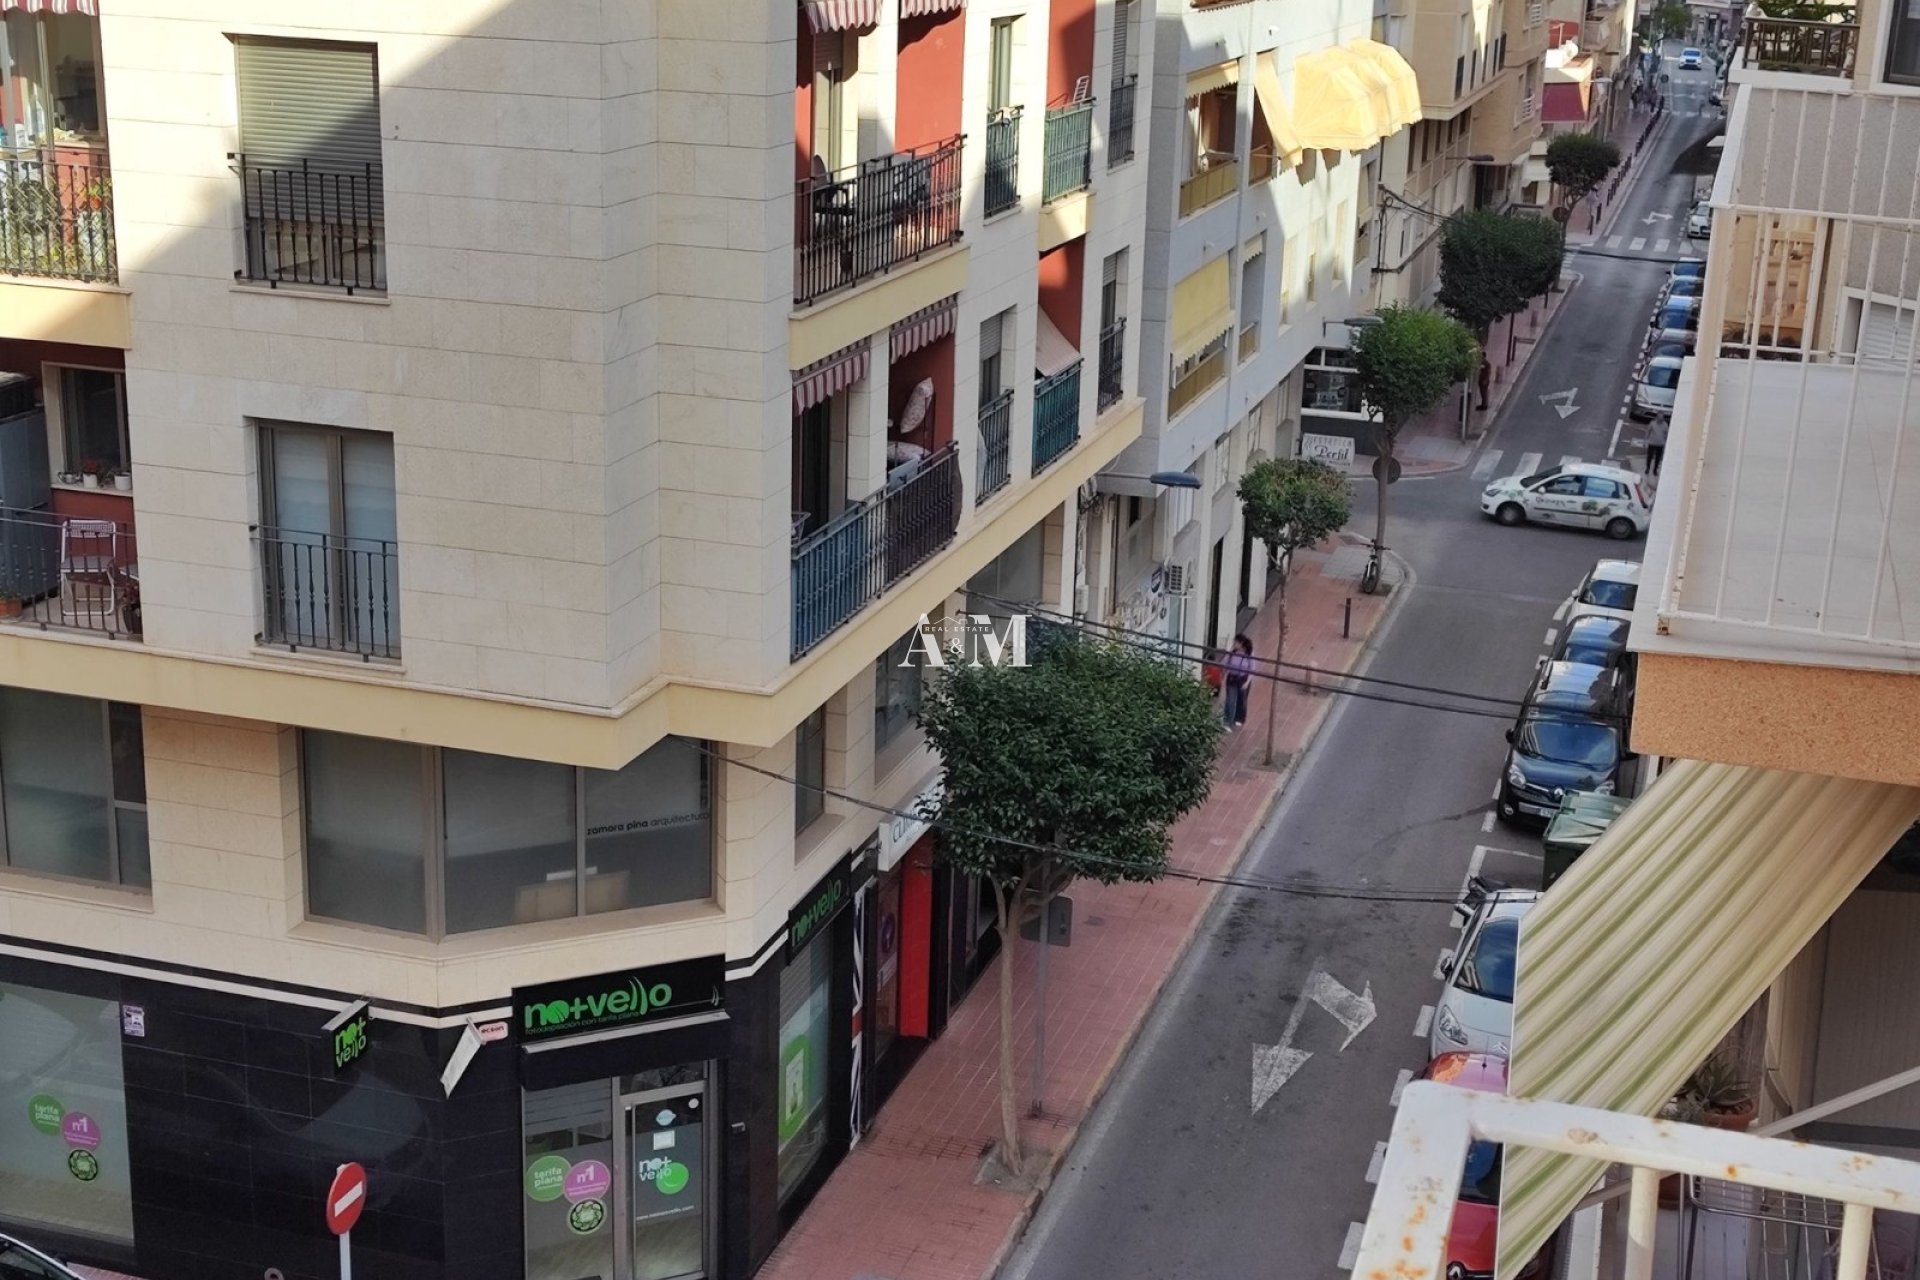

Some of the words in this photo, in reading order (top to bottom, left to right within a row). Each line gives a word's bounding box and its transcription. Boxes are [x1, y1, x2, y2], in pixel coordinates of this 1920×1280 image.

[1314, 444, 1350, 461] Perfil
[587, 823, 624, 836] zamora
[650, 811, 710, 827] arquitectura
